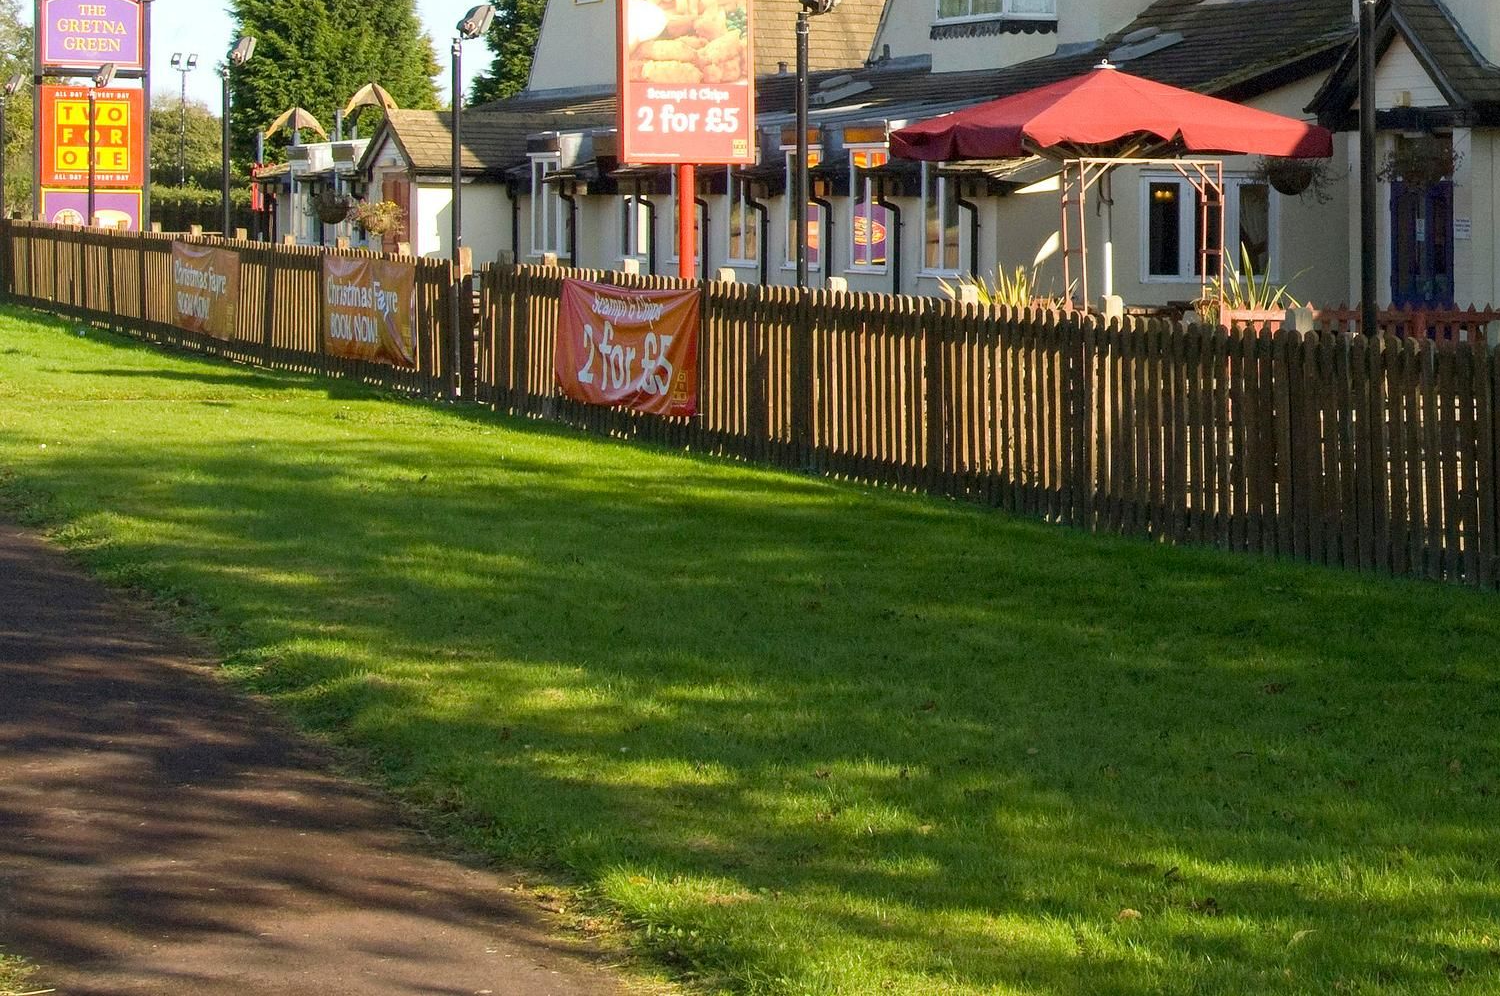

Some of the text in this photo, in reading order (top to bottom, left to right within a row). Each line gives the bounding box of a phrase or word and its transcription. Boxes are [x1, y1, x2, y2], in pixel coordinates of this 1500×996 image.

[78, 4, 107, 16] THE
[57, 18, 127, 35] GRETNA
[64, 36, 121, 52] GREEN
[63, 106, 122, 121] TWO
[637, 104, 740, 133] 2 for £5
[63, 128, 122, 144] FOR
[327, 274, 398, 322] Christmas Fayre
[330, 312, 352, 340] BOOK
[578, 324, 594, 384] 2
[599, 321, 636, 391] for
[636, 332, 673, 396] £5
